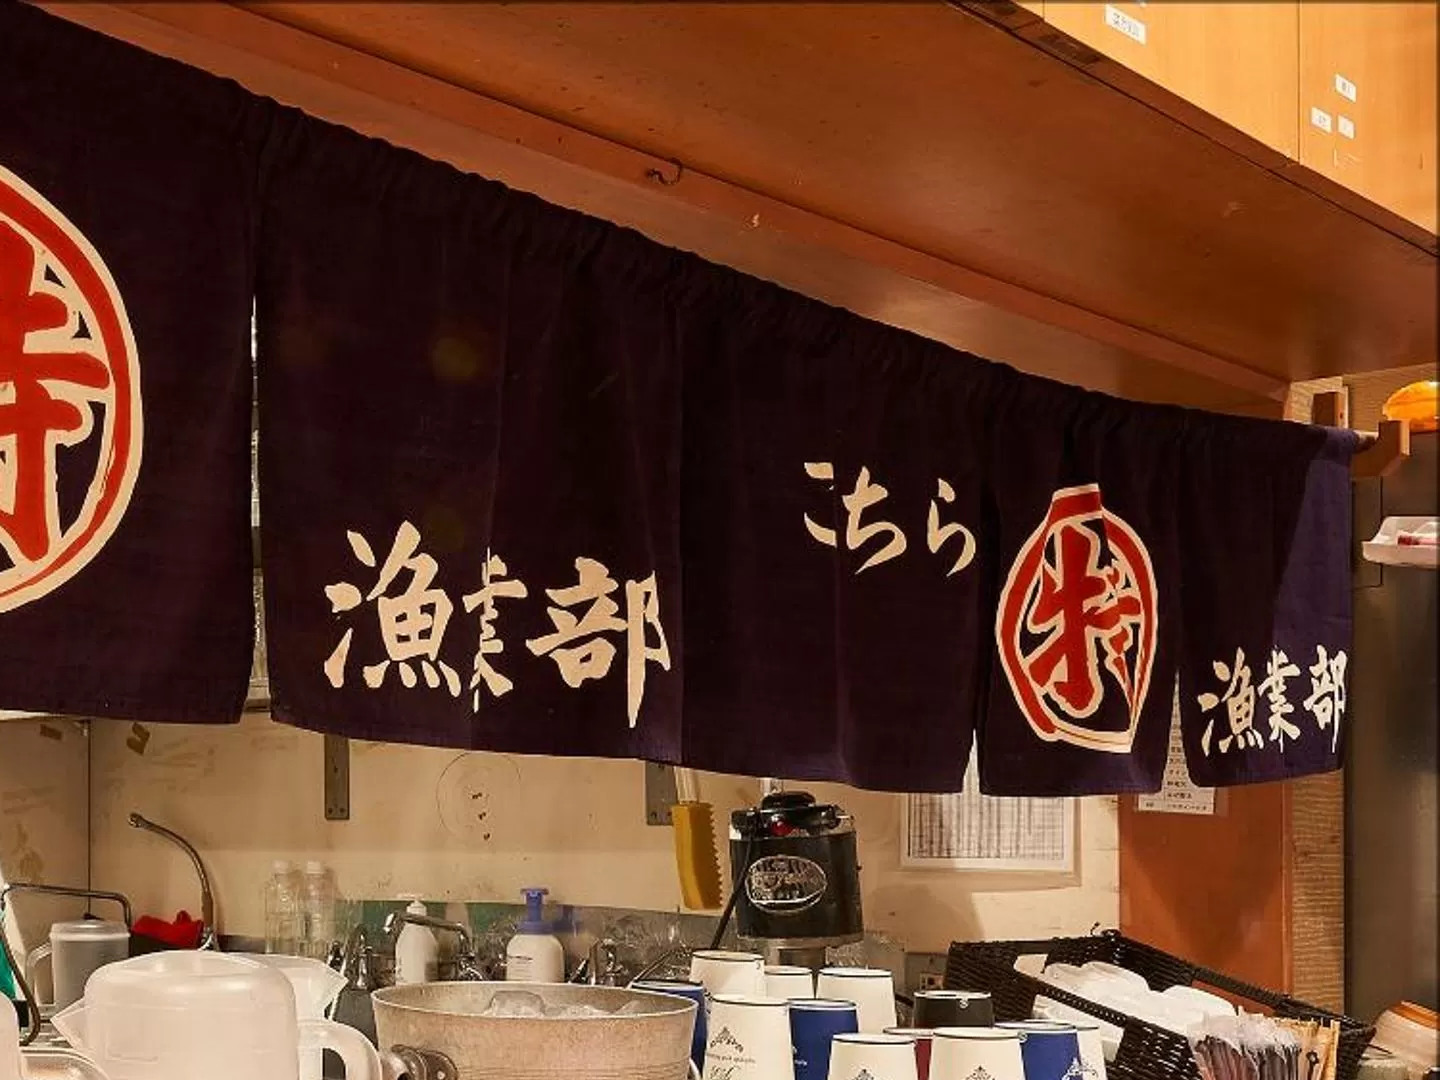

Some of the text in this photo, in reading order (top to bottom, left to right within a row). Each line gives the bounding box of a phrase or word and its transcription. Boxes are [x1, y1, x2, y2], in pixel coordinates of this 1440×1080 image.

[803, 461, 977, 577] こちら
[1196, 644, 1348, 757] 漁業部
